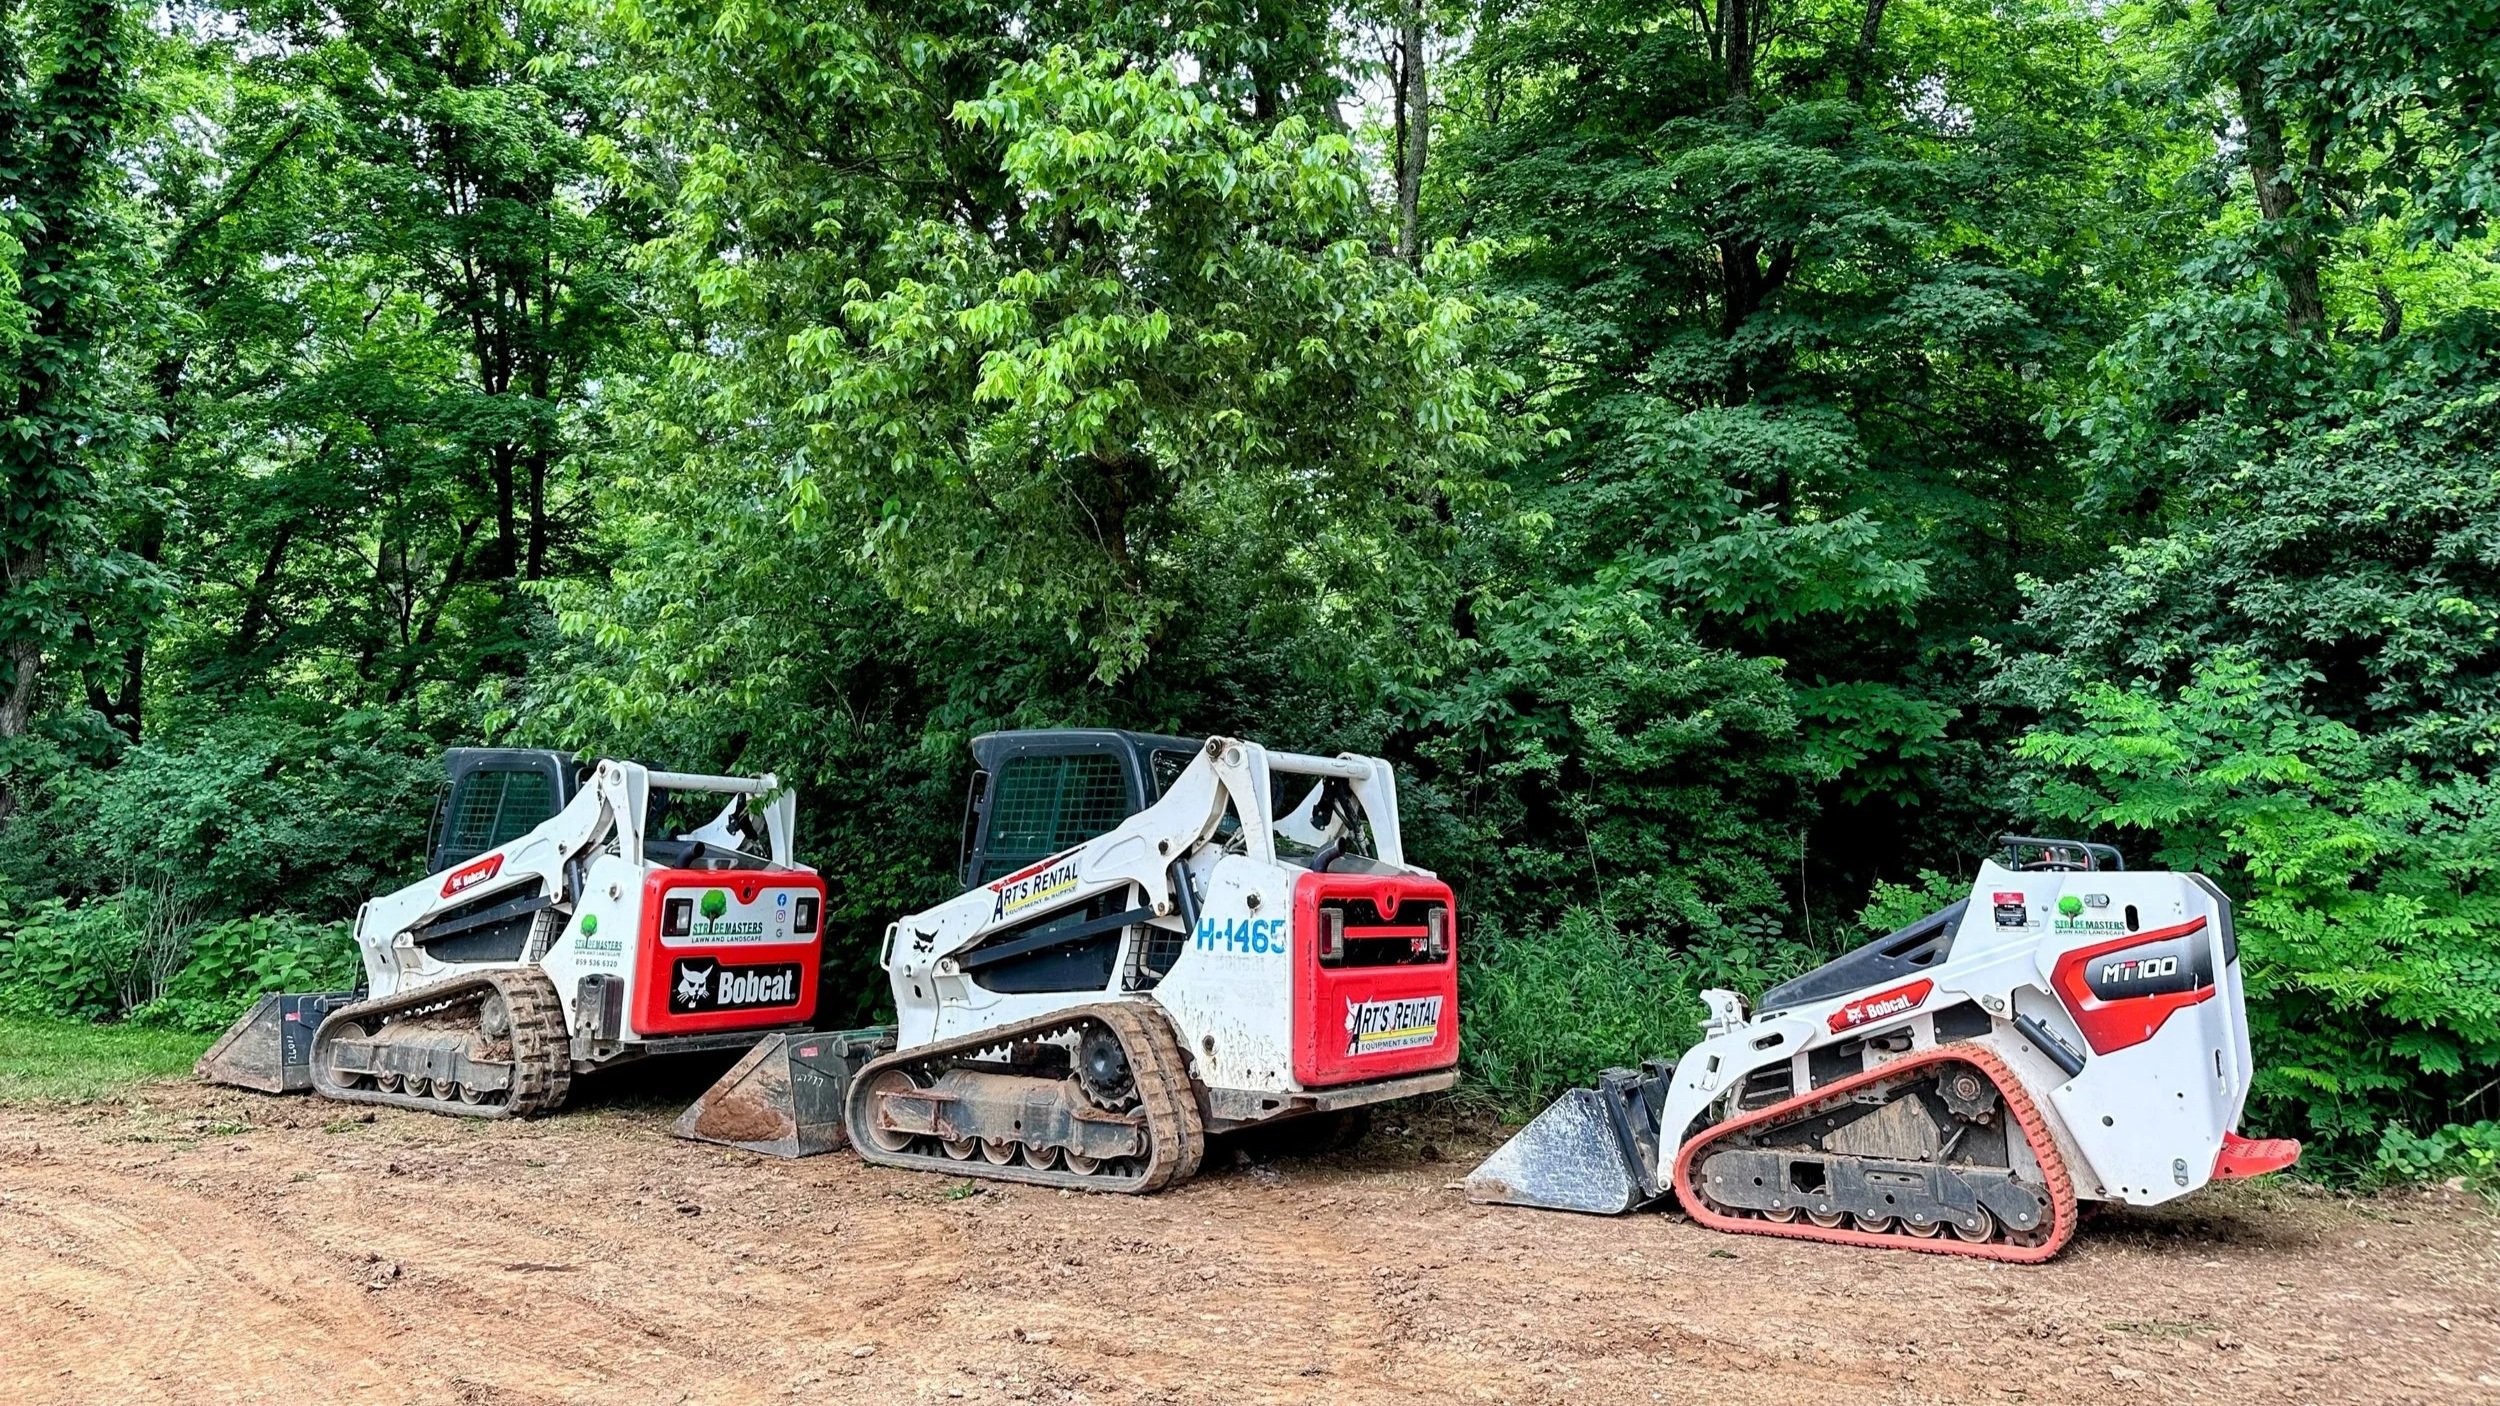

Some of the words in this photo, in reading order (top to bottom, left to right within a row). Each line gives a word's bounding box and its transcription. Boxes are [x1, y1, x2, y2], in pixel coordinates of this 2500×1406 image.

[992, 881, 1028, 923] ART'S
[1033, 862, 1078, 895] RENTAL
[1005, 899, 1043, 917] EQUIPMENT
[1051, 886, 1077, 899] SUPPLY
[692, 922, 763, 936] STRIPEMASTERS
[692, 936, 710, 944] LAWN
[727, 935, 762, 943] LANDSCAPE
[1197, 917, 1286, 954] H-1465
[2101, 955, 2178, 984] MT100
[717, 970, 793, 1005] Bobcat
[1866, 994, 1911, 1019] Bobcat
[1346, 1003, 1390, 1054] ART'S
[1393, 1001, 1437, 1031] RENTAL
[1361, 1040, 1400, 1051] EQUIPMENT
[1410, 1036, 1433, 1044] SUPPLY
